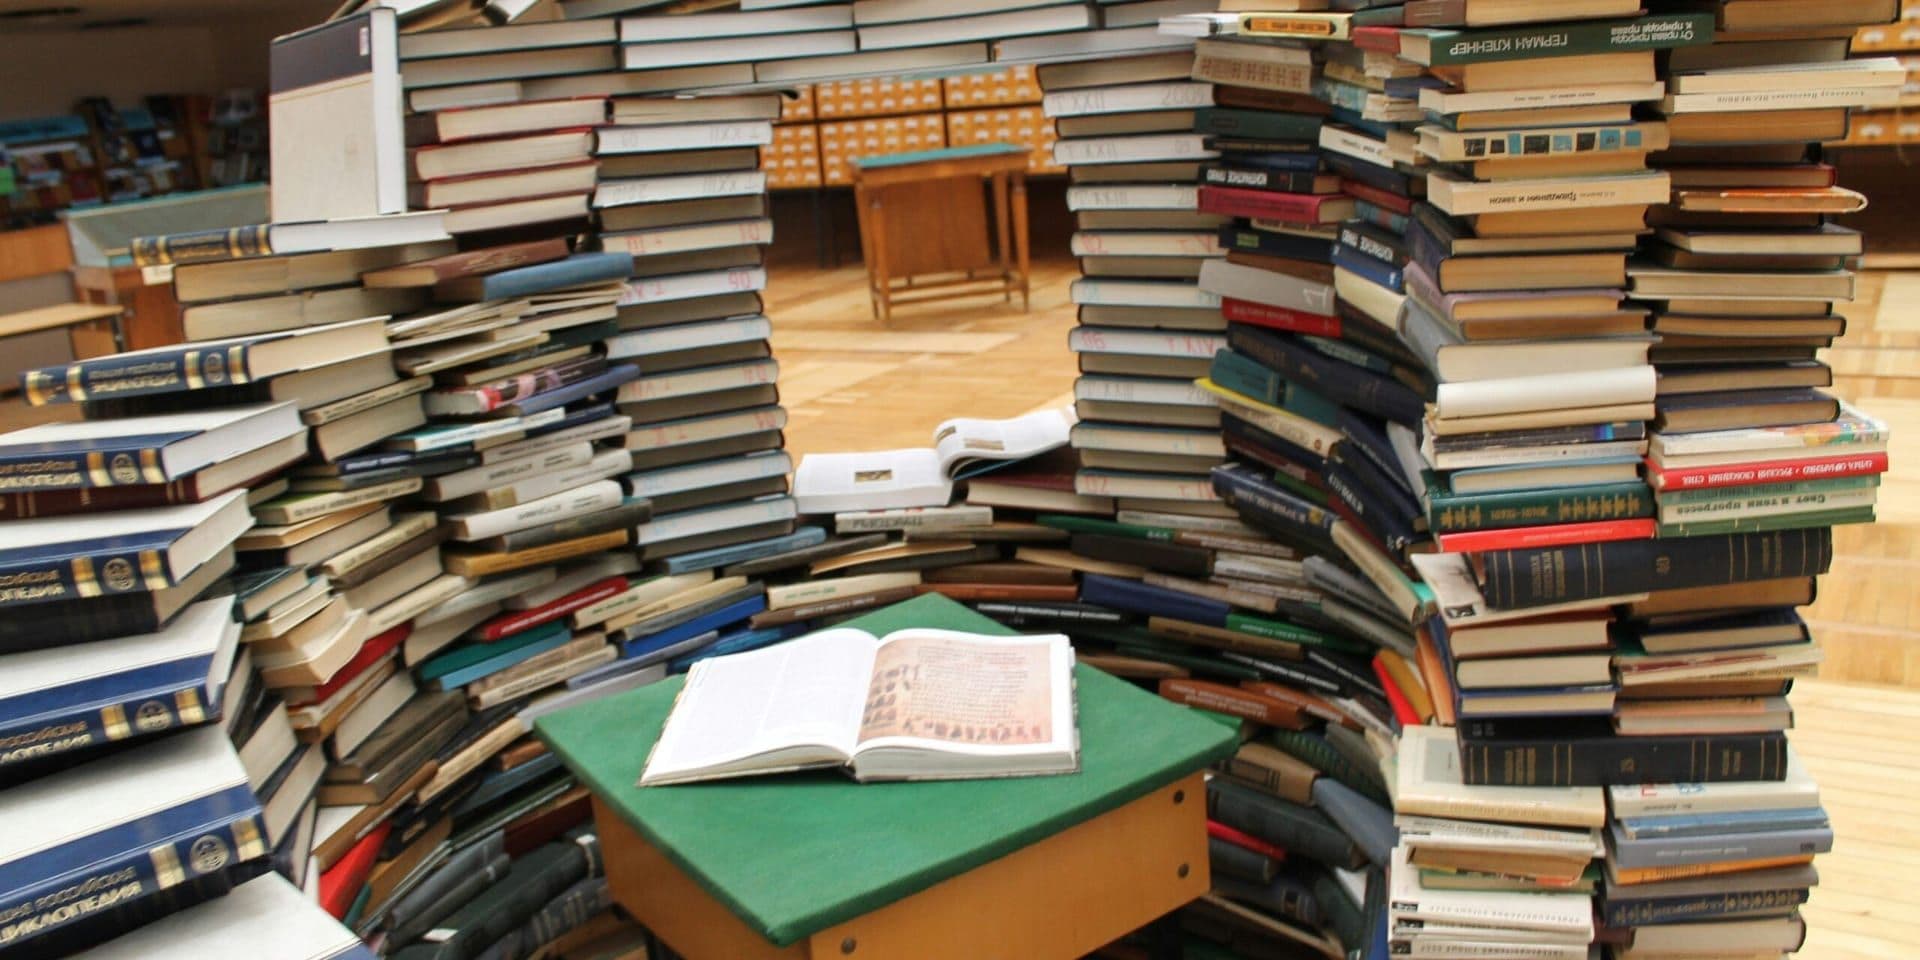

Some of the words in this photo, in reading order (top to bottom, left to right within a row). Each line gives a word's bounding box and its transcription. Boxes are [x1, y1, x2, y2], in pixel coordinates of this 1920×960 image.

[1449, 38, 1511, 55] КЛЕННЕР
[1515, 33, 1568, 50] ГЕРМАН
[1747, 498, 1778, 508] тени
[1795, 494, 1826, 505] Свет
[1676, 501, 1741, 516] прогресса
